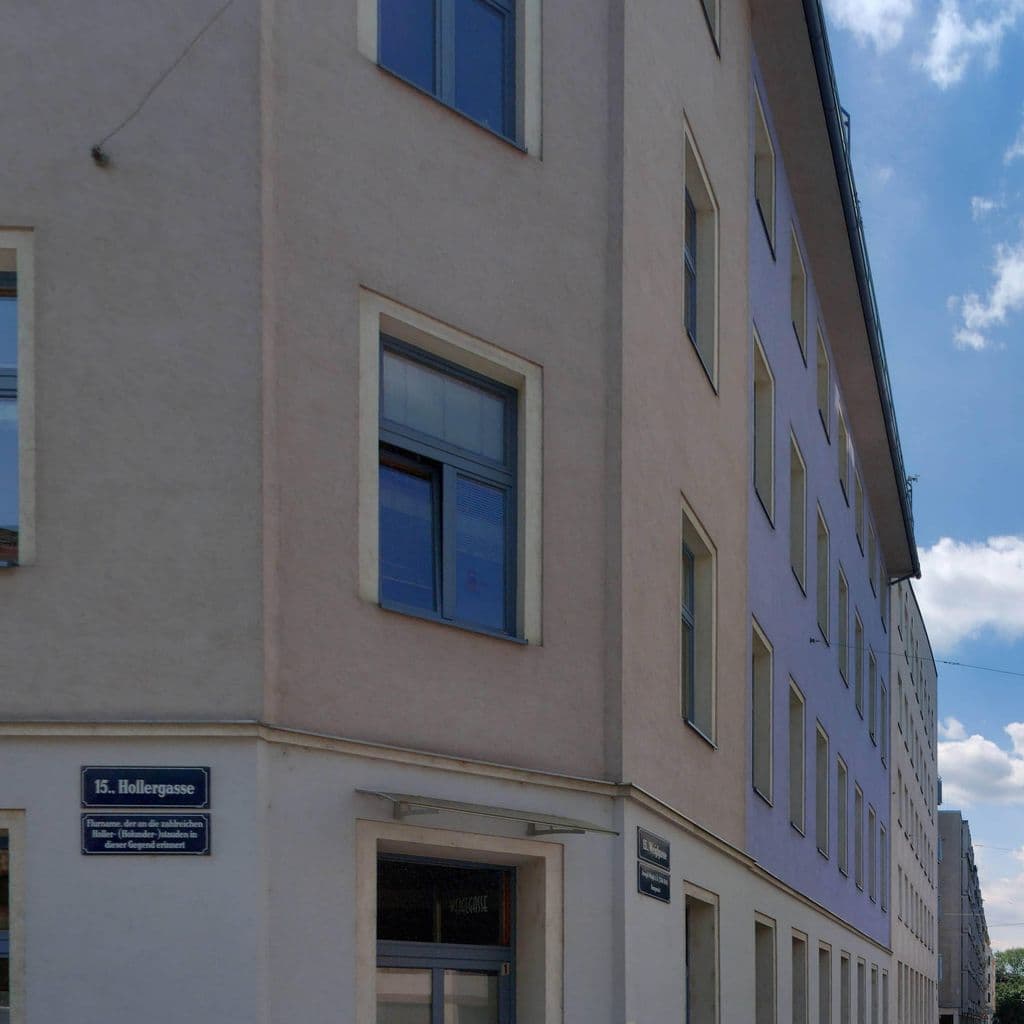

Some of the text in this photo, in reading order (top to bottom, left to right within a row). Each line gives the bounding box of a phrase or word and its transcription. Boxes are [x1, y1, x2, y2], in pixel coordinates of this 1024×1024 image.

[118, 779, 196, 798] Hollergasse
[123, 819, 136, 828] der
[148, 819, 160, 828] die
[190, 830, 198, 838] in
[104, 840, 127, 849] dieser
[127, 840, 156, 851] Gegend
